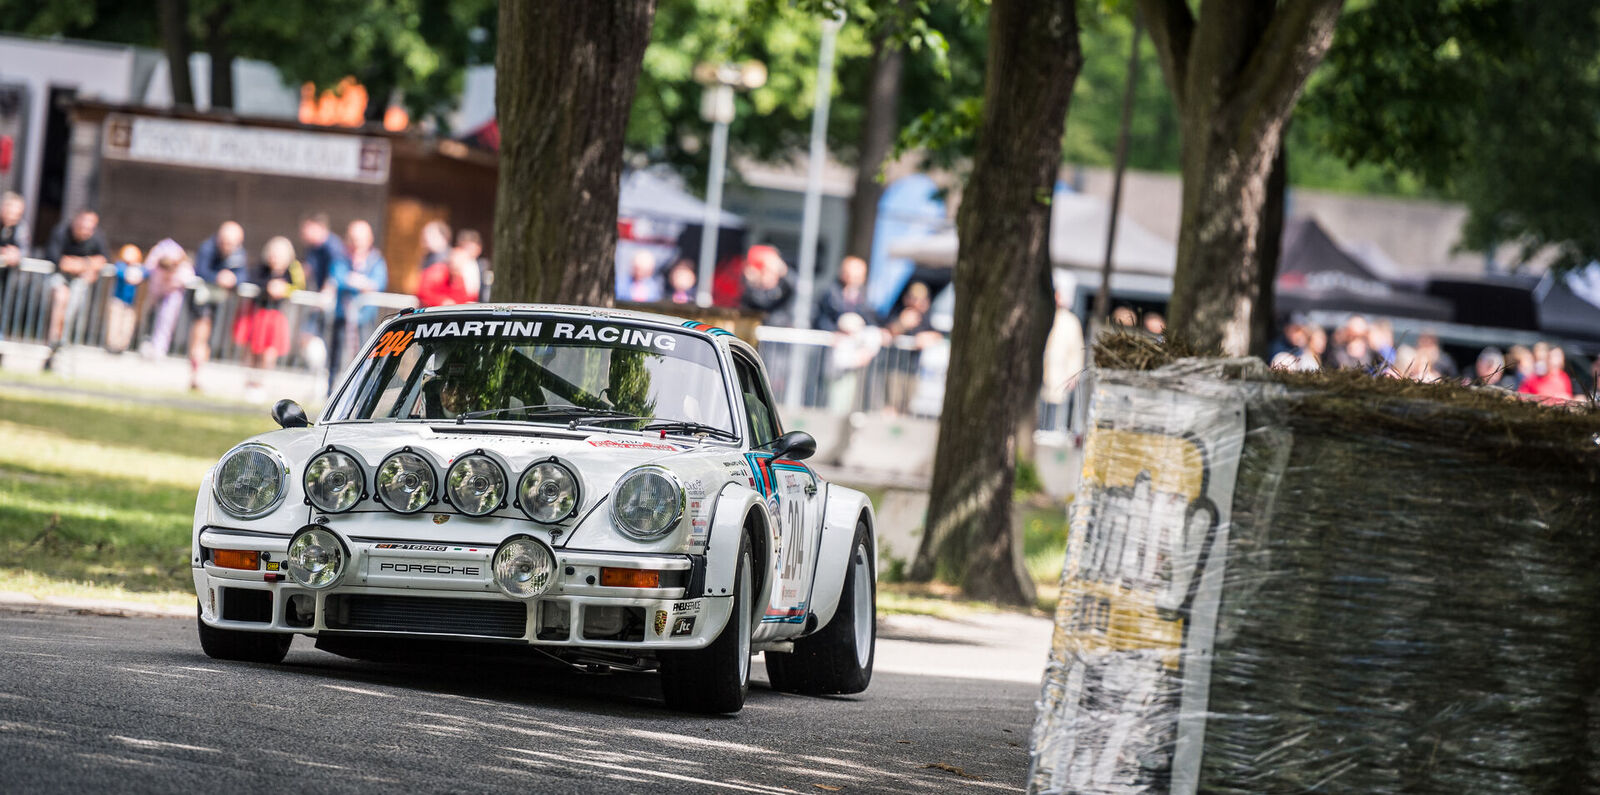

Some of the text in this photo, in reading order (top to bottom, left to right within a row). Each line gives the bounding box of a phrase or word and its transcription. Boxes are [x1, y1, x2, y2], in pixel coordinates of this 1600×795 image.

[368, 330, 415, 359] 204
[414, 321, 676, 350] MARTINI RACING
[782, 500, 805, 580] 204
[380, 563, 480, 576] PORSCHE
